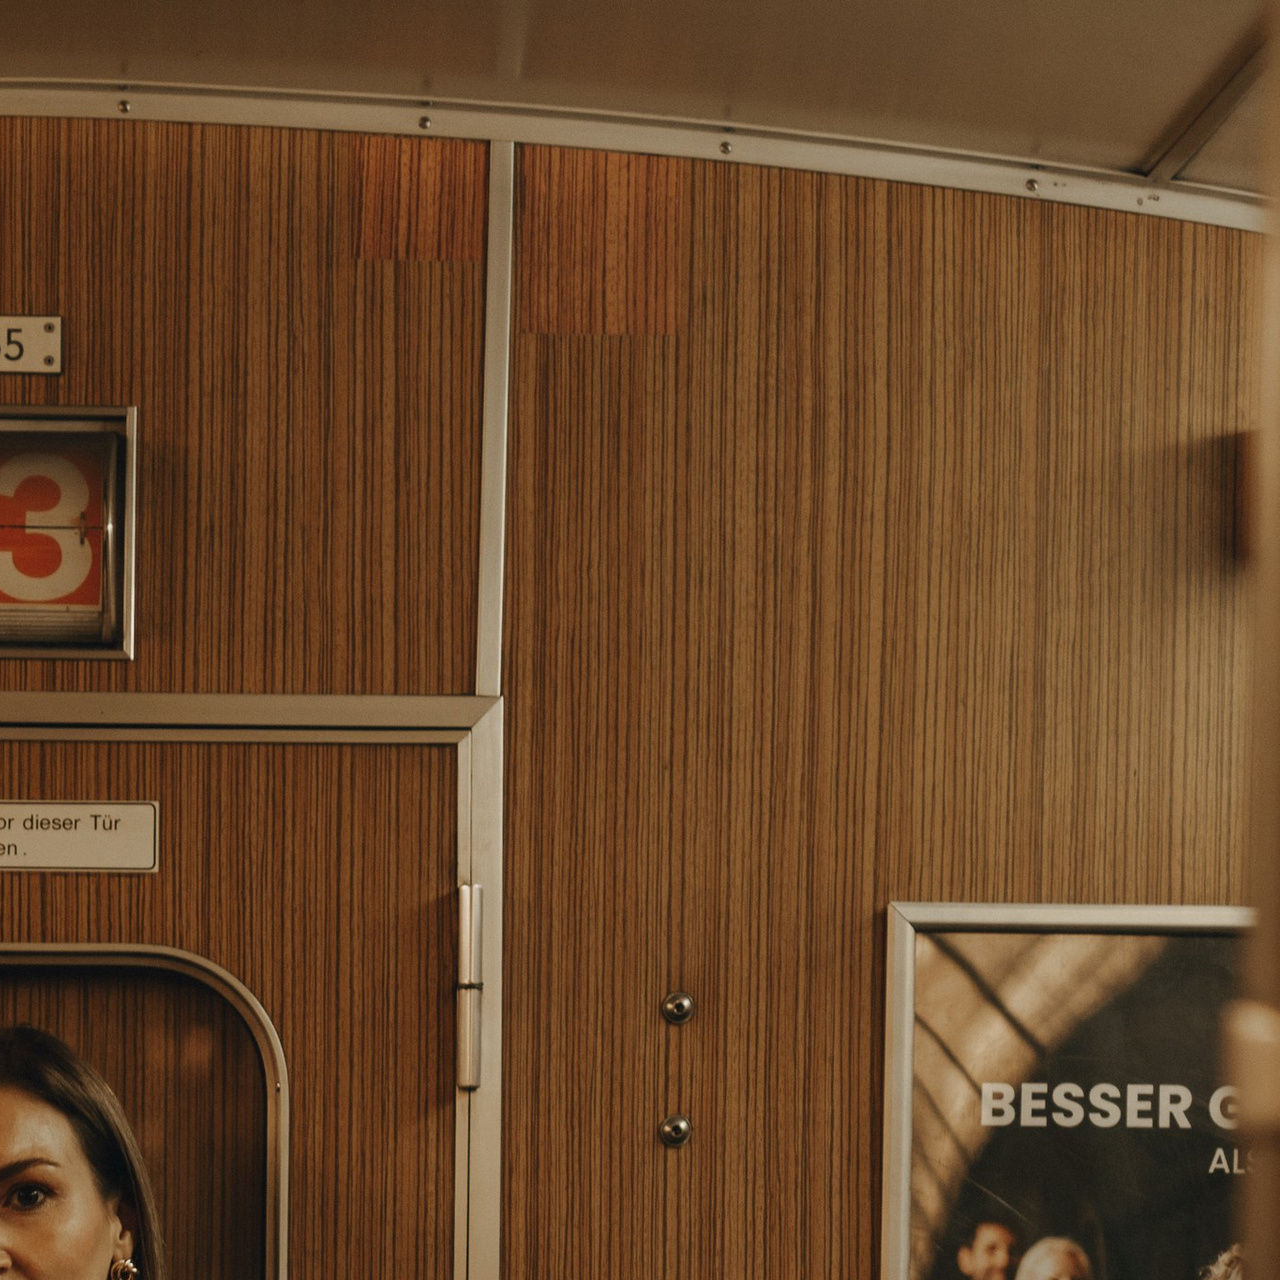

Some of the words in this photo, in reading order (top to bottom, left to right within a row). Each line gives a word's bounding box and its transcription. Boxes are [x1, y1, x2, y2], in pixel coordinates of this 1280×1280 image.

[22, 814, 81, 831] dieser
[89, 814, 121, 831] Tür
[980, 1081, 1193, 1129] BESSER
[1208, 1084, 1240, 1130] G
[1208, 1147, 1252, 1175] AL
